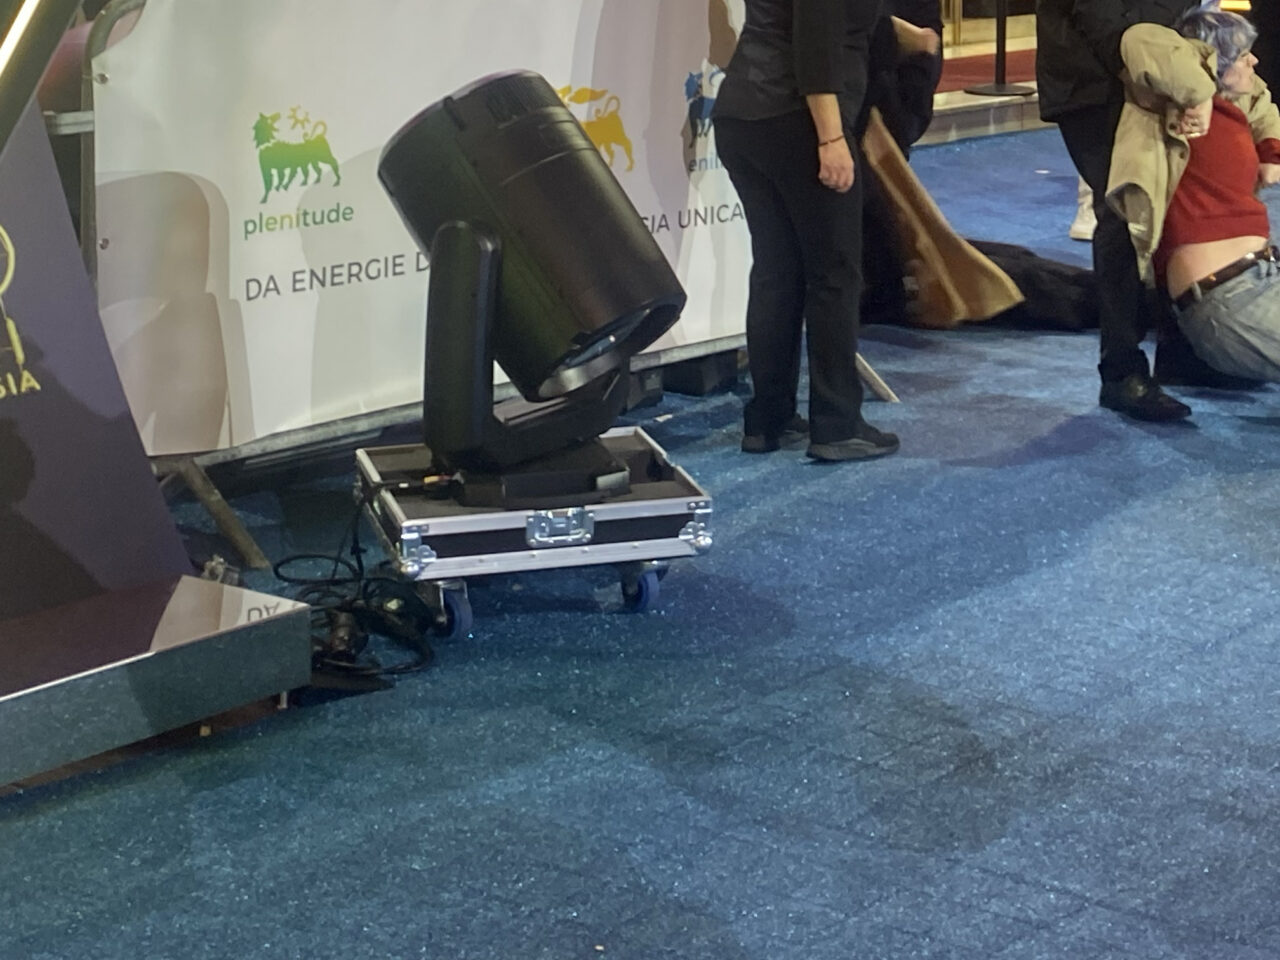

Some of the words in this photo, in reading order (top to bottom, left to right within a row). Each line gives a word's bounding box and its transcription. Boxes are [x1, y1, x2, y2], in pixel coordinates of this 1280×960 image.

[244, 202, 354, 240] plenitude
[245, 274, 281, 301] DA
[291, 254, 405, 293] ENERGIE
[678, 201, 745, 229] UNICA
